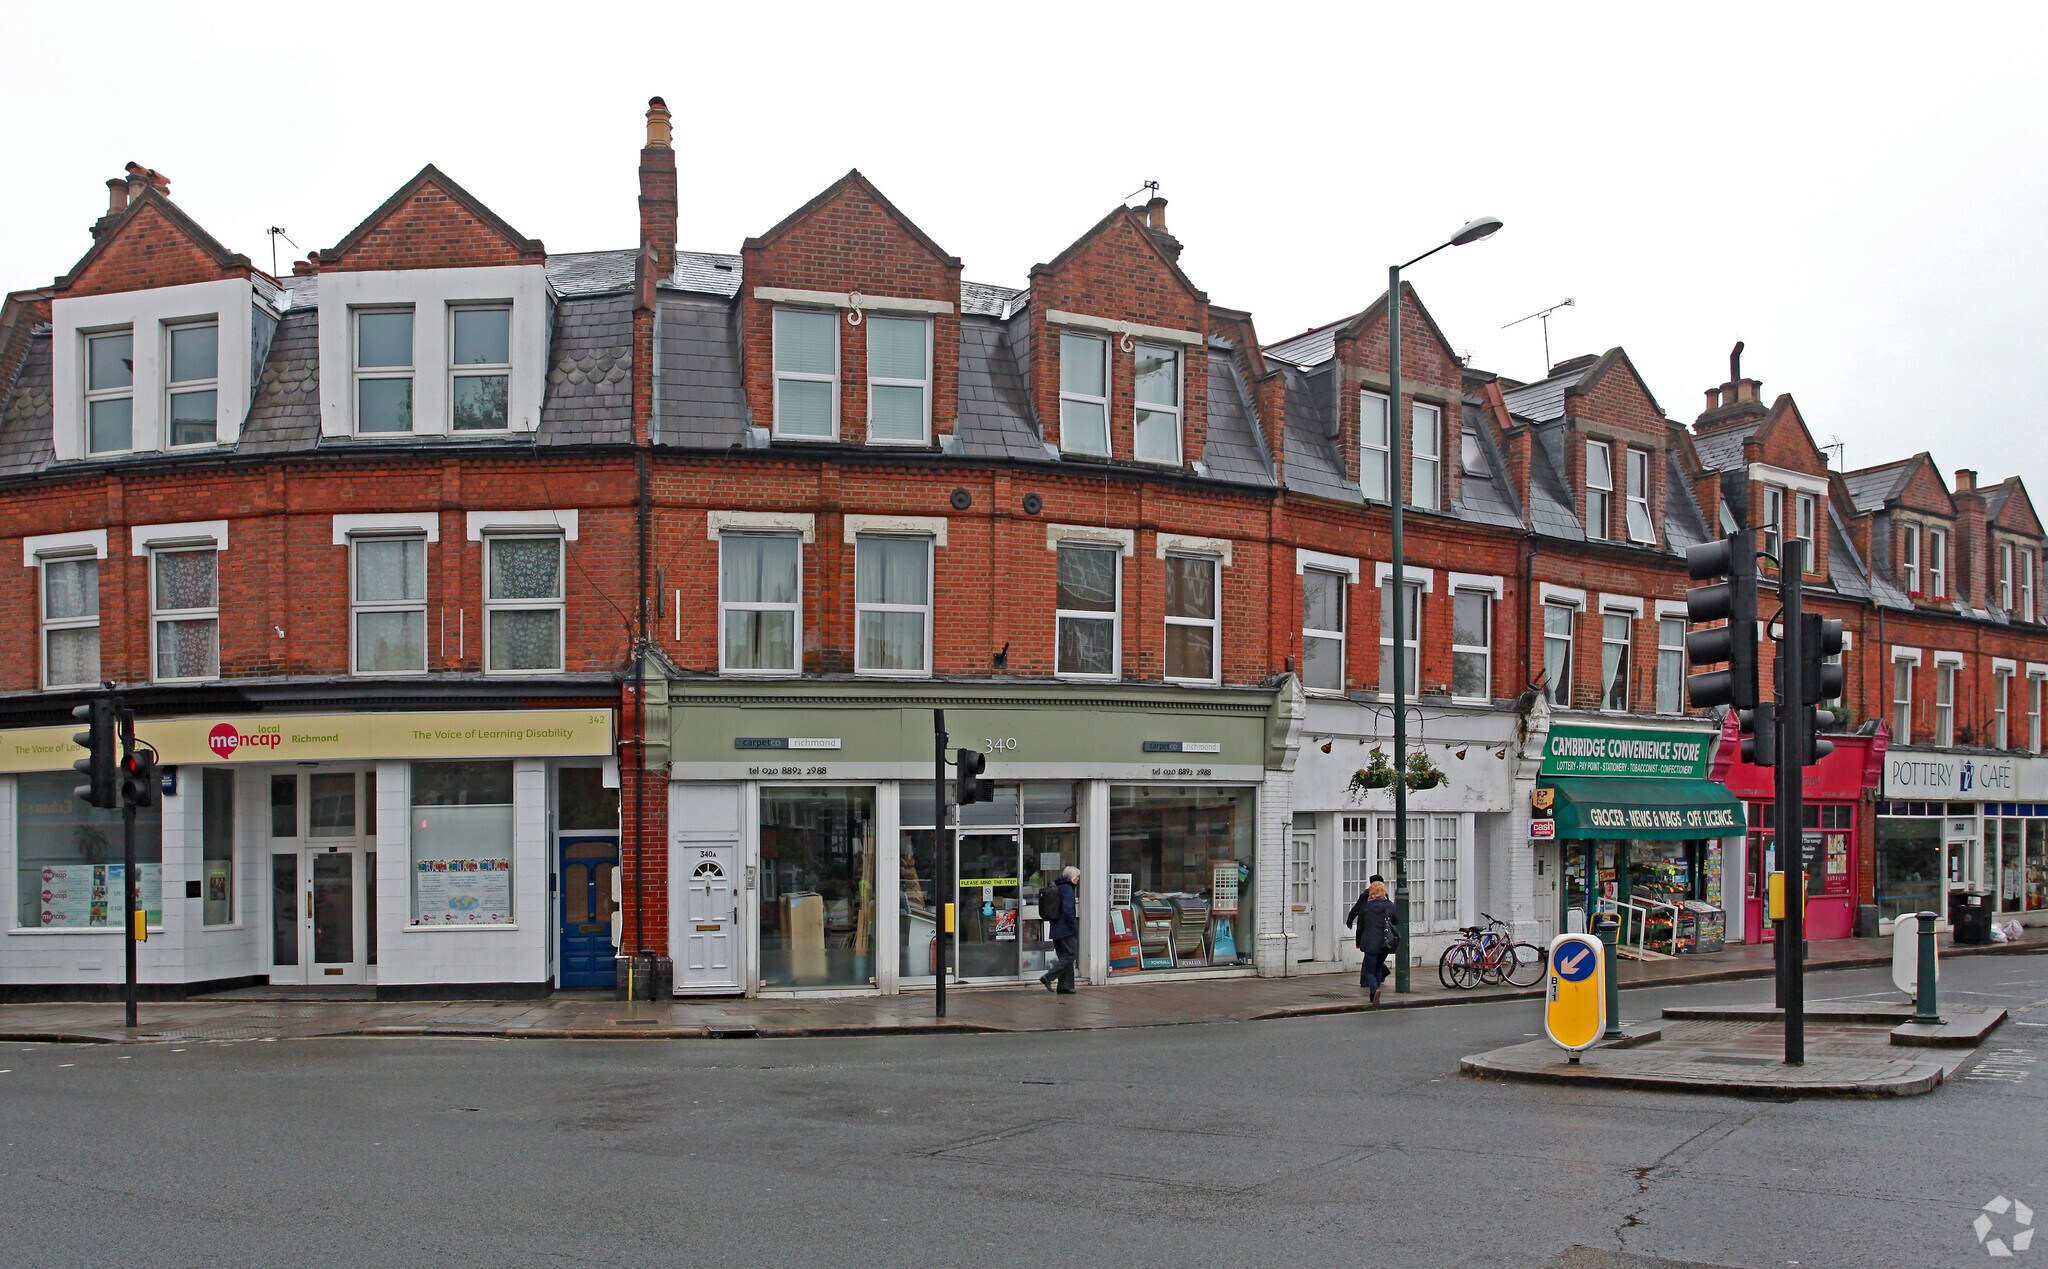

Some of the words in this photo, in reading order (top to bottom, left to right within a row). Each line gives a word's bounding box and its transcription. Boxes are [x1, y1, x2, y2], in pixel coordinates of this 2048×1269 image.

[588, 715, 605, 724] 342
[258, 724, 280, 733] local
[291, 733, 339, 743] Richmond
[413, 730, 432, 739] The
[434, 730, 462, 739] Voice
[465, 729, 476, 739] of
[478, 729, 523, 740] Learning
[526, 728, 573, 738] Disability
[210, 733, 281, 750] mencap
[742, 739, 781, 748] carpetco
[794, 738, 836, 747] richmond
[985, 737, 1017, 754] 340
[15, 745, 30, 754] The
[32, 744, 53, 754] Voice
[55, 743, 64, 752] of
[1186, 743, 1217, 751] richmond
[1551, 736, 1606, 758] CAMBRIDGE
[1608, 739, 1672, 760] CONVENIENCE
[1672, 742, 1701, 762] STORE
[749, 767, 760, 775] tel
[781, 767, 802, 776] 8892
[806, 767, 827, 775] 2988
[1556, 760, 1576, 771] LOTTERY
[1579, 761, 1588, 771] PAY
[1588, 761, 1601, 771] POINT
[1602, 762, 1628, 772] STATIONERY
[1630, 763, 1658, 773] TOBACCONIST
[1661, 764, 1694, 774] CONFECTIONERY
[1892, 760, 1954, 787] POTTERY
[1980, 759, 2011, 789] CAFÉ
[1591, 808, 1626, 826] GROCER
[1628, 809, 1653, 827] NEWS
[1652, 810, 1660, 827] &
[1658, 810, 1682, 827] MAGS
[1687, 810, 1702, 827] OFF
[1703, 809, 1734, 827] LICENCE
[1533, 821, 1553, 831] cash
[42, 892, 67, 900] mencap
[42, 913, 66, 921] mencap
